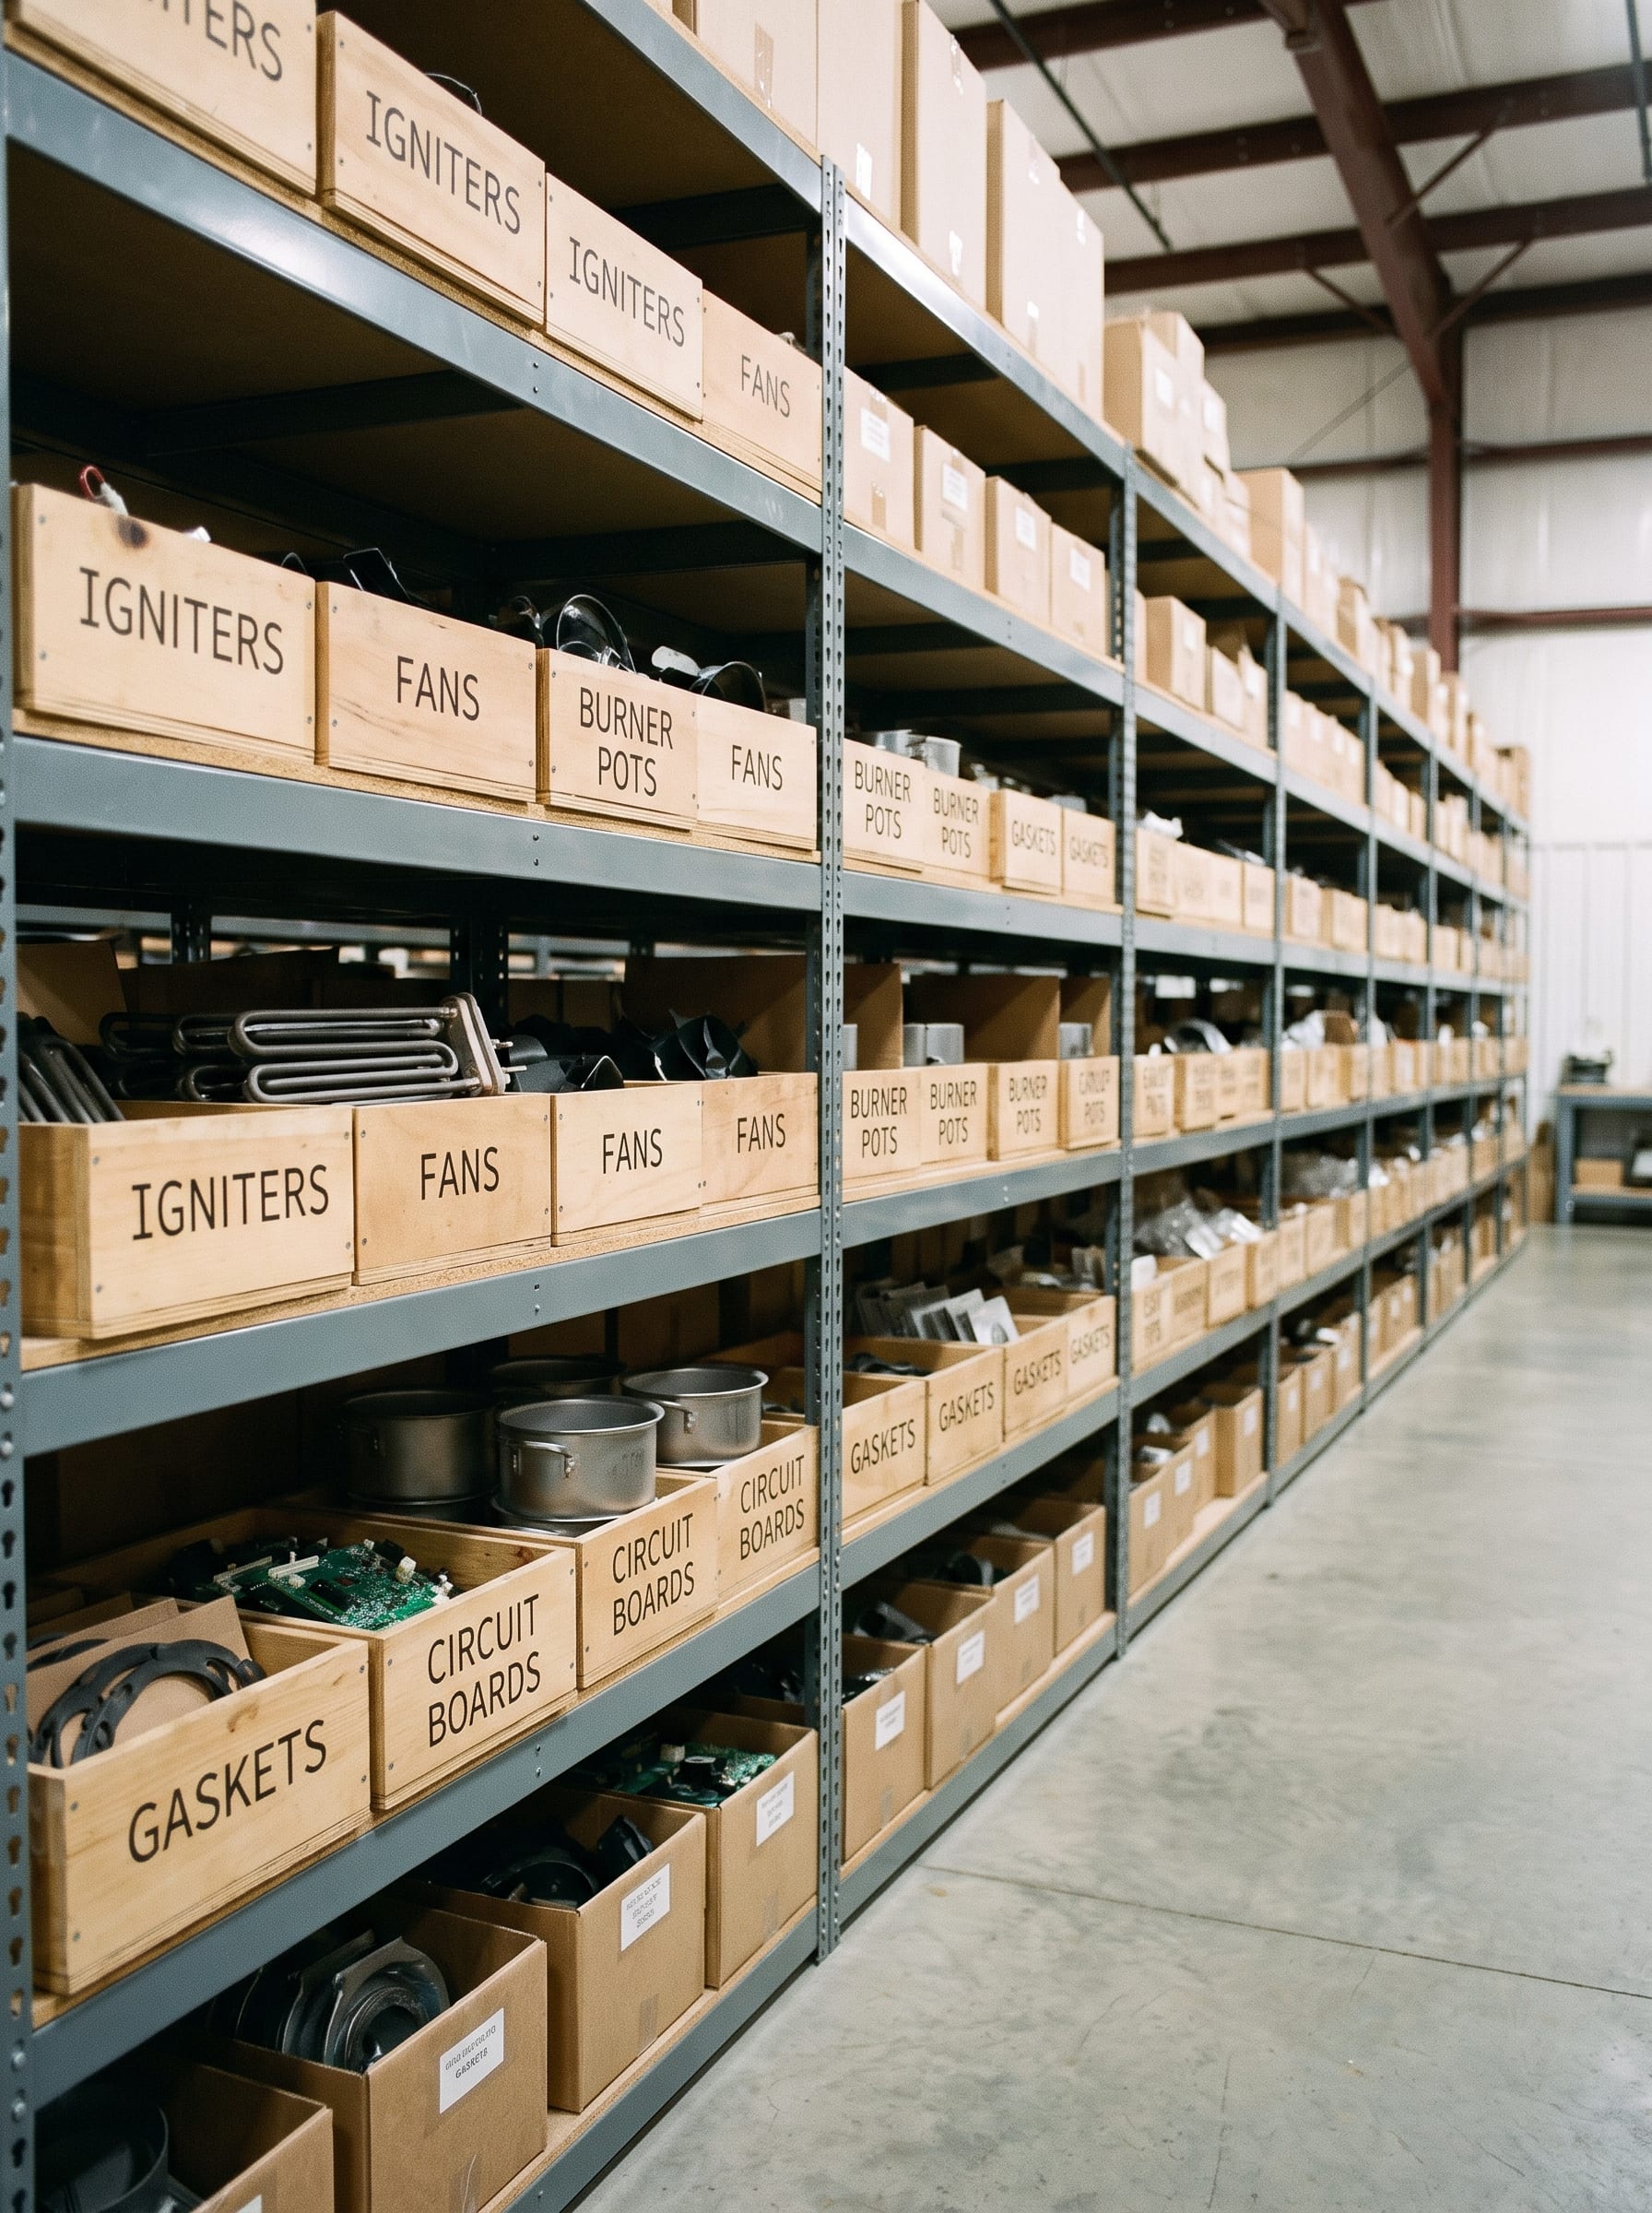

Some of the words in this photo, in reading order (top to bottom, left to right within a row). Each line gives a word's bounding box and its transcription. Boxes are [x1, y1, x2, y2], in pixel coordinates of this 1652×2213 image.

[366, 89, 520, 235] IGNITERS
[569, 237, 684, 349] IGNITERS
[741, 355, 790, 418] FANS
[80, 567, 283, 674] IGNITERS
[397, 656, 479, 721] FANS
[581, 687, 673, 750] BURNER
[599, 746, 656, 797] POTS
[732, 745, 783, 790] FANS
[856, 761, 910, 801] BURNER
[866, 804, 901, 839] POTS
[934, 787, 977, 822] BURNER
[942, 826, 970, 858] POTS
[1013, 821, 1055, 856] GASKETS
[852, 1087, 907, 1118] BURNER
[931, 1081, 975, 1110] BURNER
[1009, 1076, 1046, 1102] BURNER
[738, 1113, 785, 1153] FANS
[862, 1126, 897, 1157] POTS
[939, 1117, 967, 1144] POTS
[1018, 1108, 1040, 1133] POTS
[421, 1147, 499, 1200] FANS
[603, 1129, 662, 1174] FANS
[132, 1165, 328, 1240] IGNITERS
[1072, 1326, 1108, 1364] GASKETS
[1014, 1350, 1061, 1395] GASKETS
[939, 1382, 993, 1432] GASKETS
[851, 1419, 914, 1473] GASKETS
[741, 1456, 804, 1514] CIRCUIT
[612, 1514, 694, 1584] CIRCUIT
[740, 1498, 804, 1560] BOARDS
[613, 1563, 695, 1636] BOARDS
[428, 1594, 540, 1684] CIRCUIT
[429, 1653, 540, 1747] BOARDS
[129, 1720, 326, 1863] GASKETS
